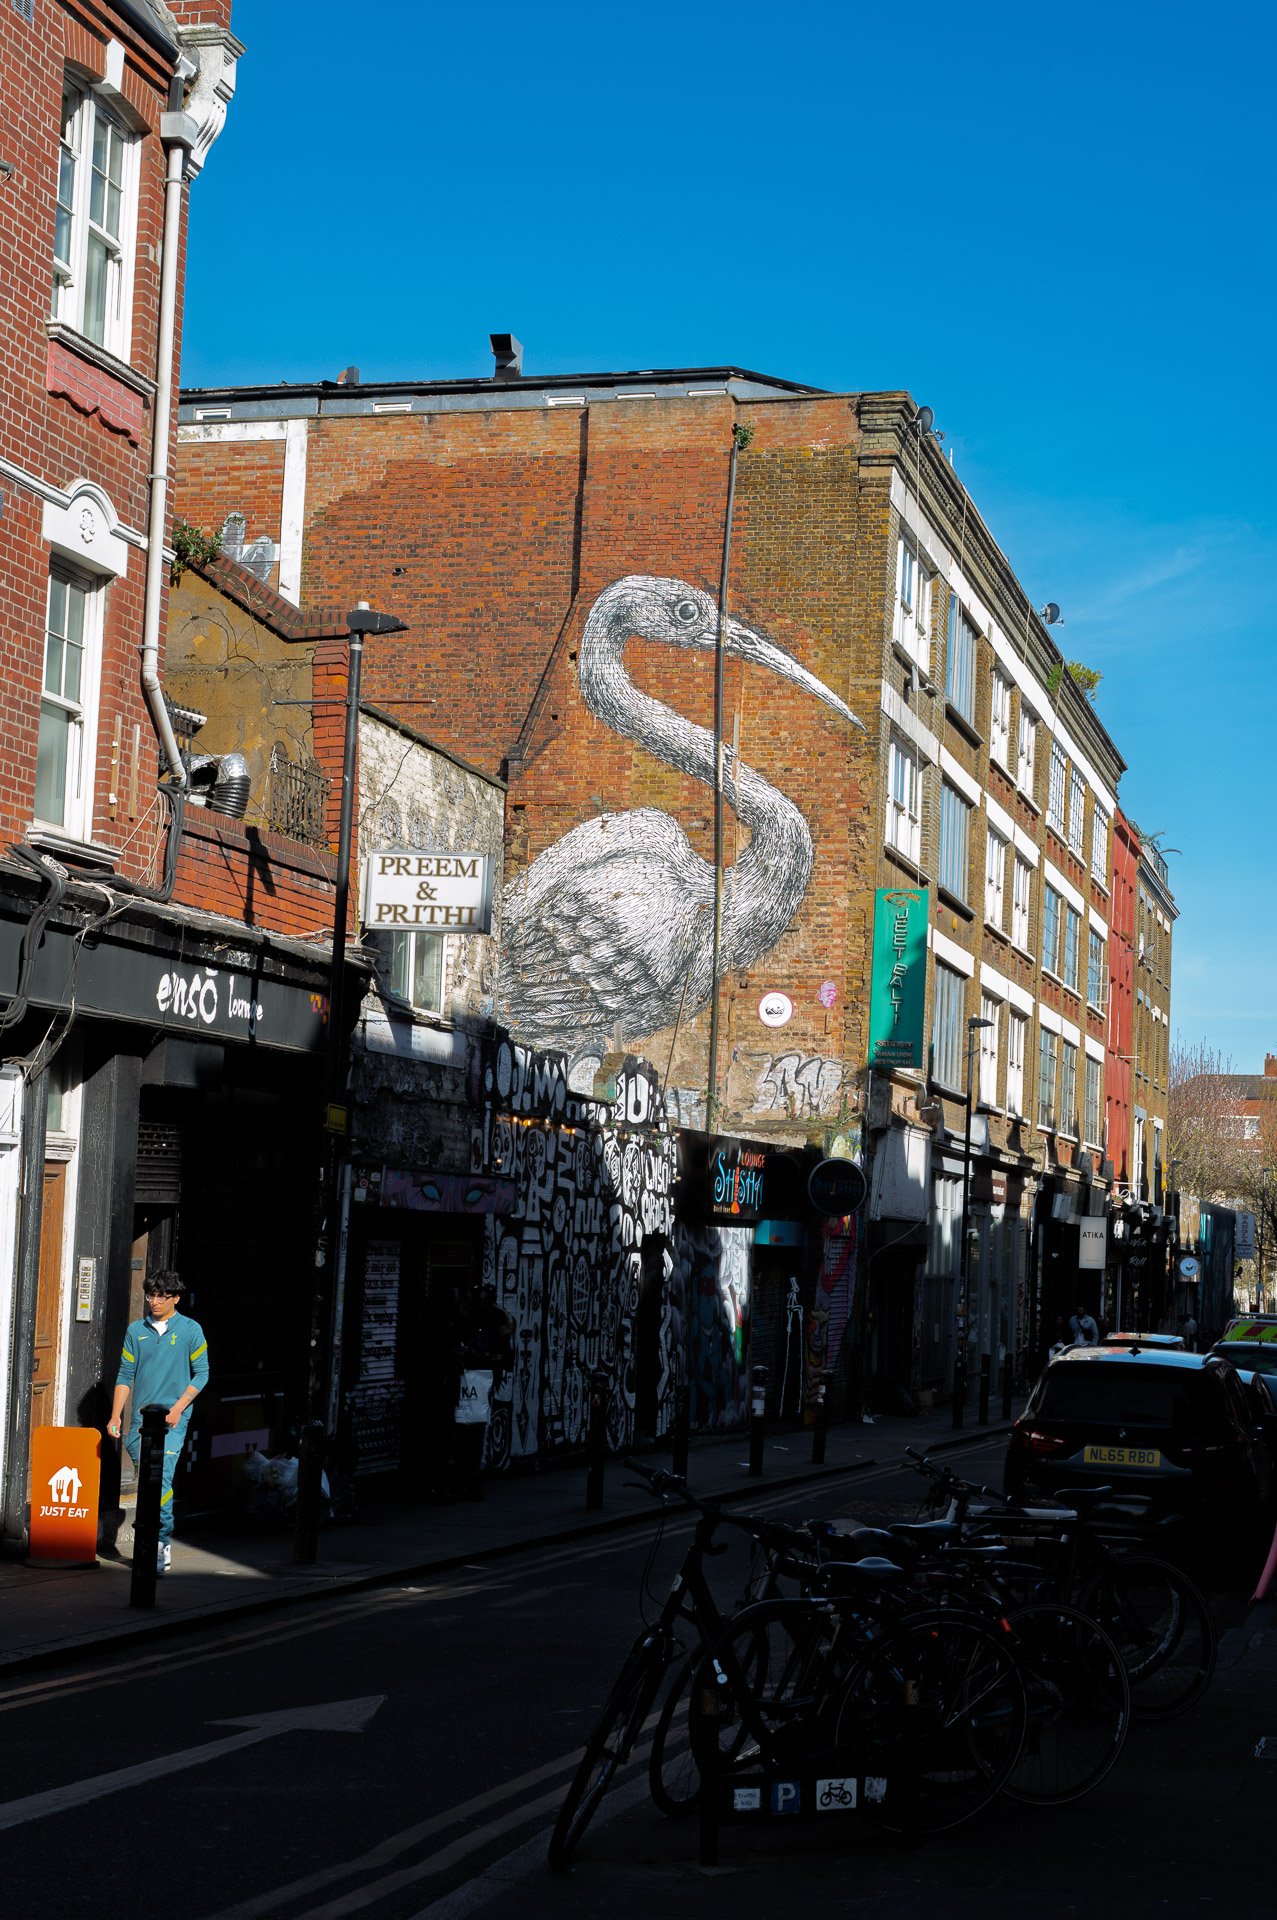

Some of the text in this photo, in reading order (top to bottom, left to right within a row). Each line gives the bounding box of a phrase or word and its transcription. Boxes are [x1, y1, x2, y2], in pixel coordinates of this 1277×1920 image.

[378, 857, 479, 878] PREEM
[416, 881, 438, 901] &
[375, 903, 479, 926] PRITHI
[741, 1151, 766, 1169] LOUNGE
[714, 1151, 765, 1212] SHISHA
[1082, 1231, 1104, 1239] ATIKA
[1090, 1447, 1155, 1464] NL65 RBO
[40, 1505, 89, 1518] JUST EAT
[777, 1782, 796, 1812] P
